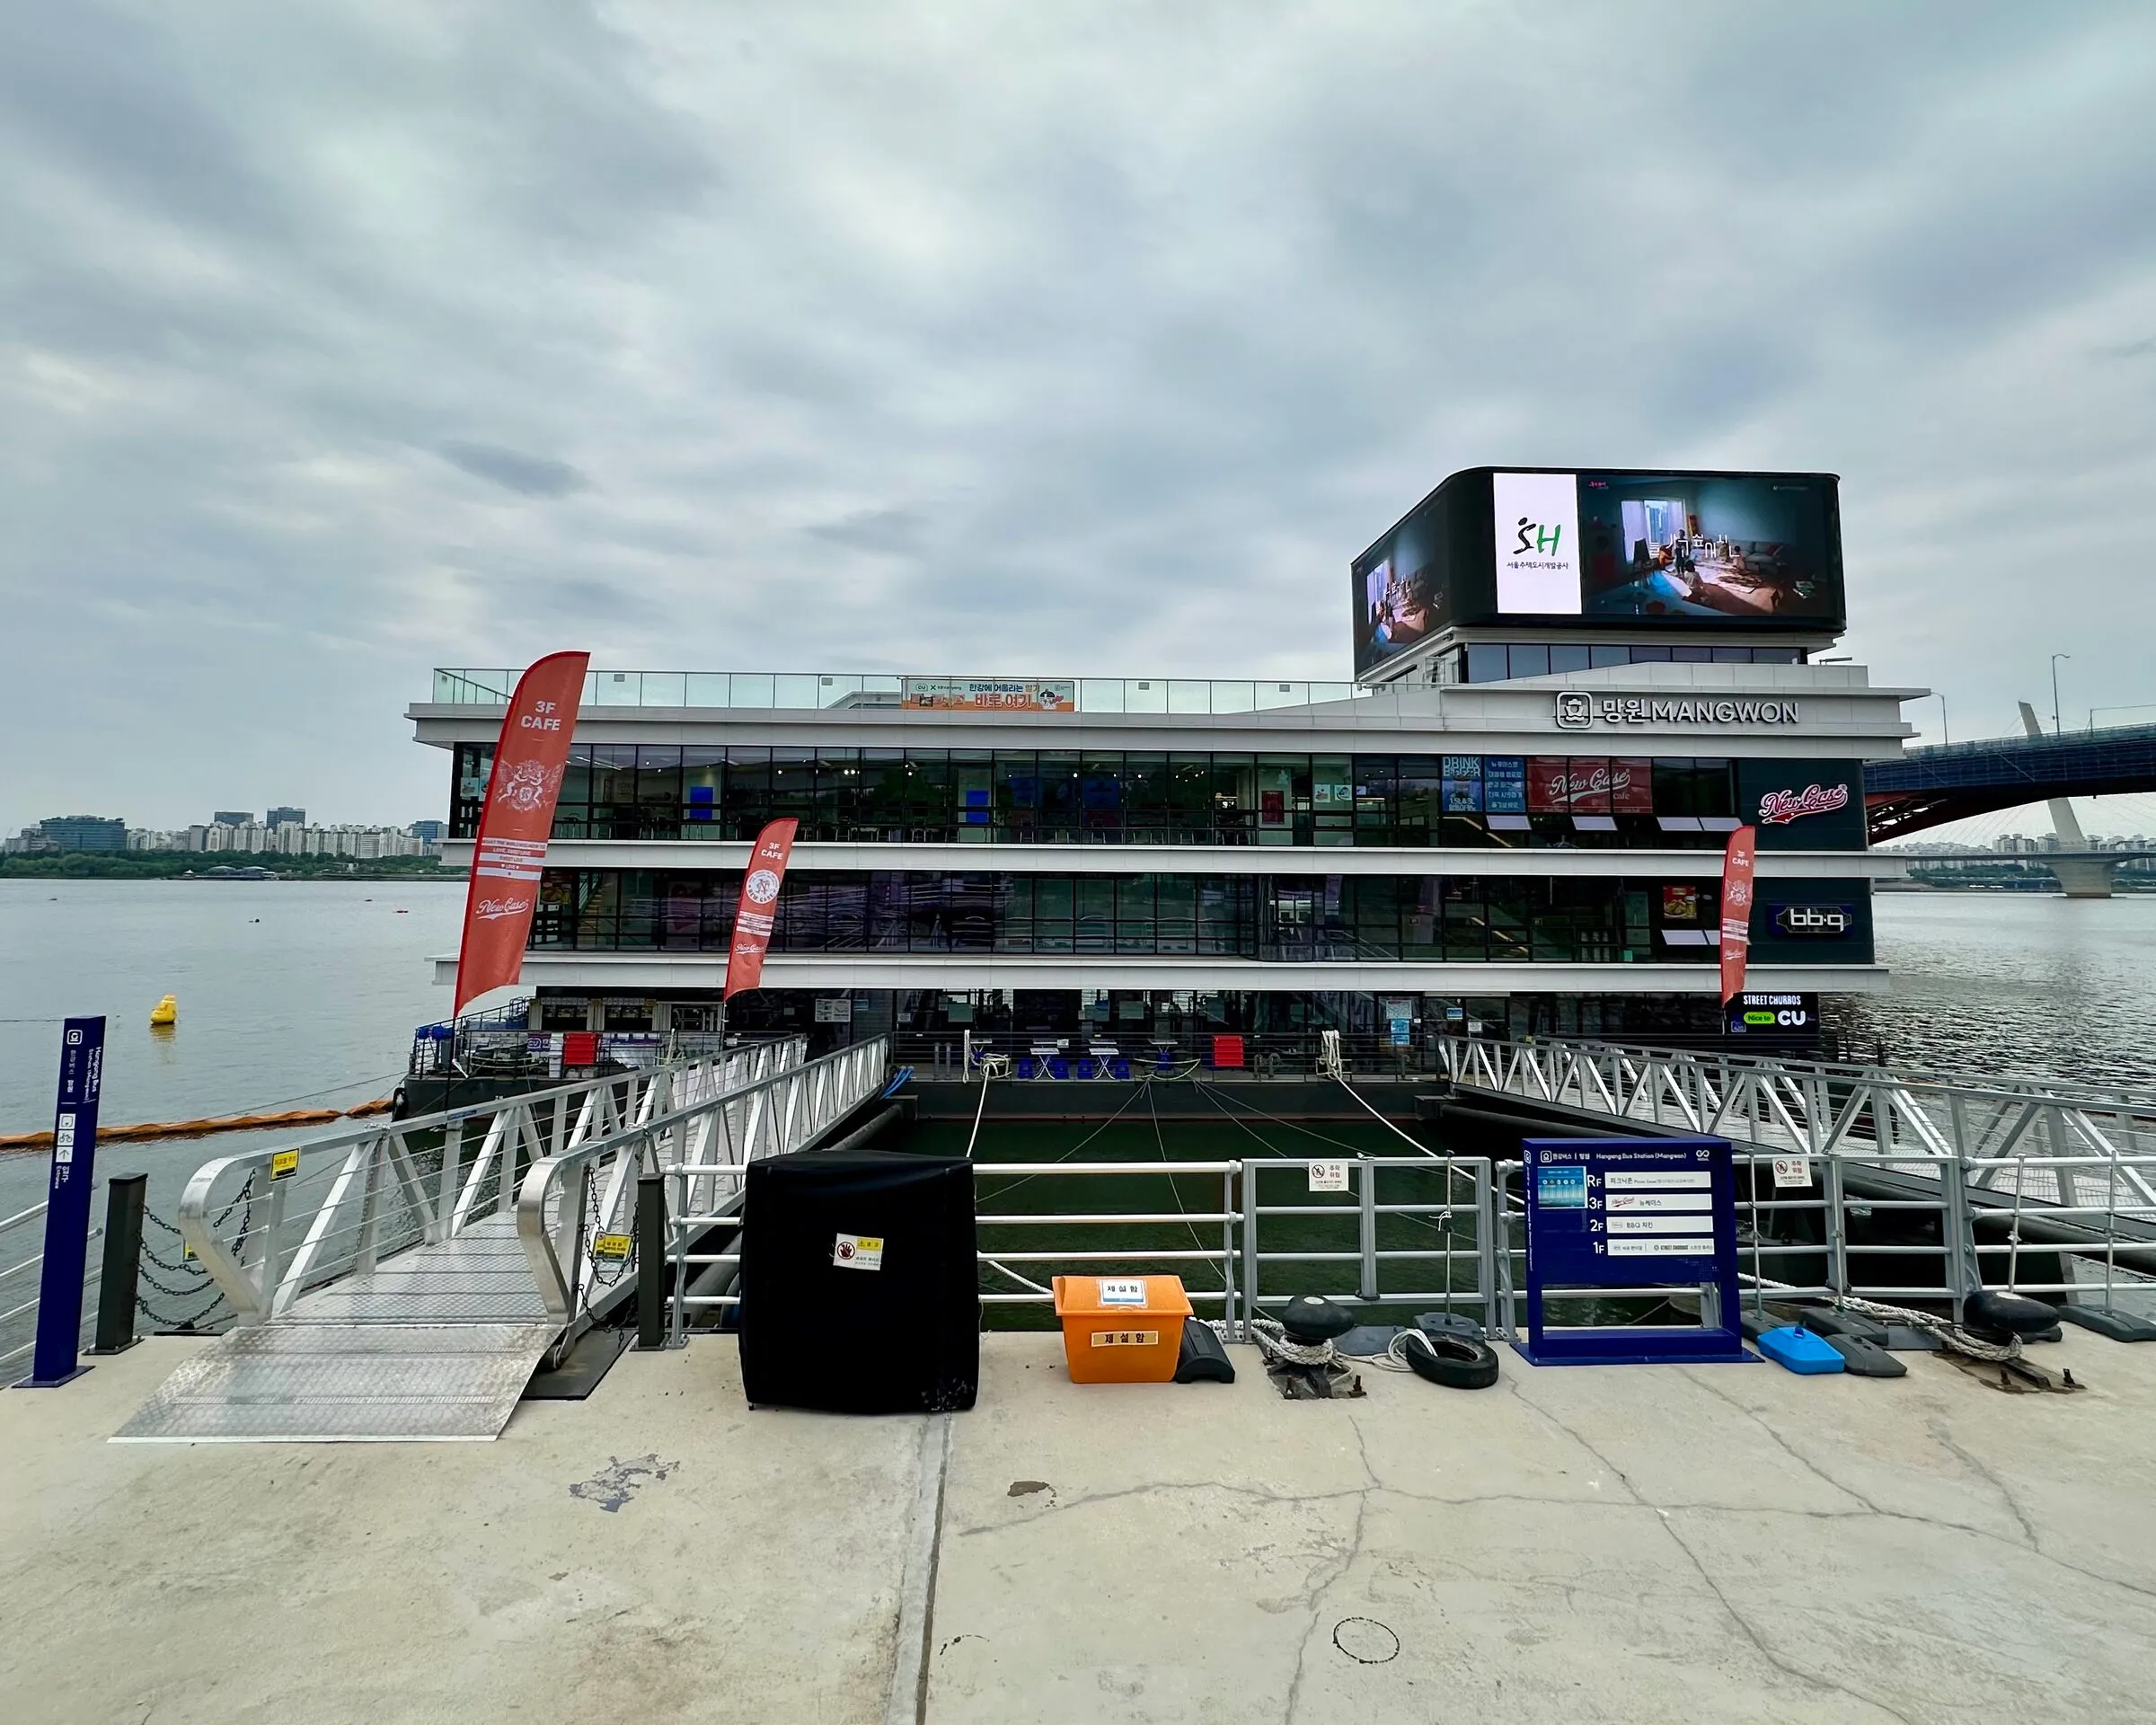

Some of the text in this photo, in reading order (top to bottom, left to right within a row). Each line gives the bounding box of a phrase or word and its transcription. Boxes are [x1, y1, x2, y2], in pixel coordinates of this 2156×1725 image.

[1513, 517, 1561, 556] SH
[1507, 561, 1568, 570] 서울주택도시개발공사
[969, 684, 993, 692] 한강에
[994, 684, 1024, 693] 어울리는
[975, 693, 1032, 708] 바로 여기
[535, 701, 556, 713] 3F
[1602, 698, 1799, 723] 망원 MANGWON
[521, 715, 561, 730] CAFE
[1443, 756, 1480, 768] DRINK
[1549, 768, 1630, 795] New Case
[1613, 792, 1630, 801] cafe
[1758, 783, 1845, 818] New Case
[768, 842, 781, 850] 3F
[761, 849, 783, 860] CAFE
[1732, 857, 1750, 867] CAFE
[476, 898, 505, 914] New
[1743, 995, 1801, 1005] STREET CHURROS
[1778, 1010, 1807, 1026] CU
[92, 1046, 102, 1092] Hangang Bus
[1595, 1153, 1622, 1161] Hangang
[1587, 1174, 1602, 1187] RF
[1589, 1197, 1603, 1209] 3F
[1590, 1219, 1604, 1232] 2F
[1594, 1242, 1604, 1254] 1F
